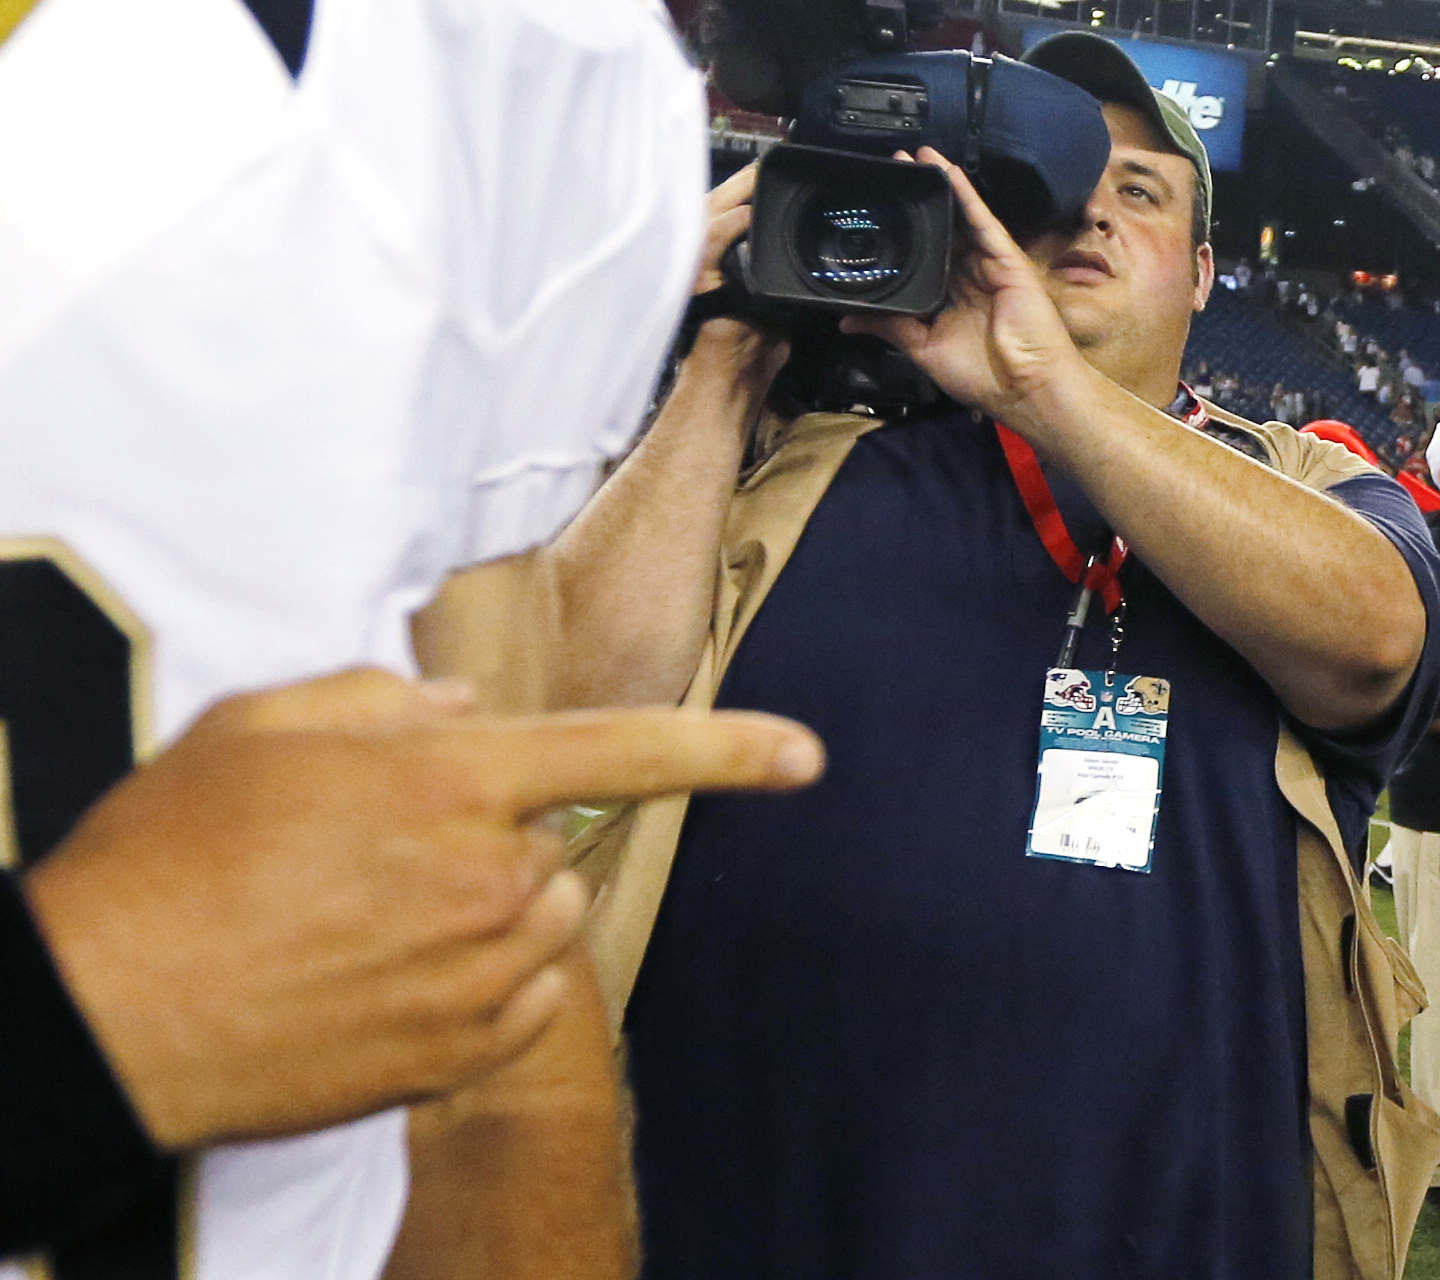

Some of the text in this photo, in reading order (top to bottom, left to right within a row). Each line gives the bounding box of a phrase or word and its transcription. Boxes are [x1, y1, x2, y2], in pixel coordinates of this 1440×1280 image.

[1093, 707, 1117, 729] A
[1067, 729, 1100, 737] POOL
[1104, 731, 1160, 744] CAMERA
